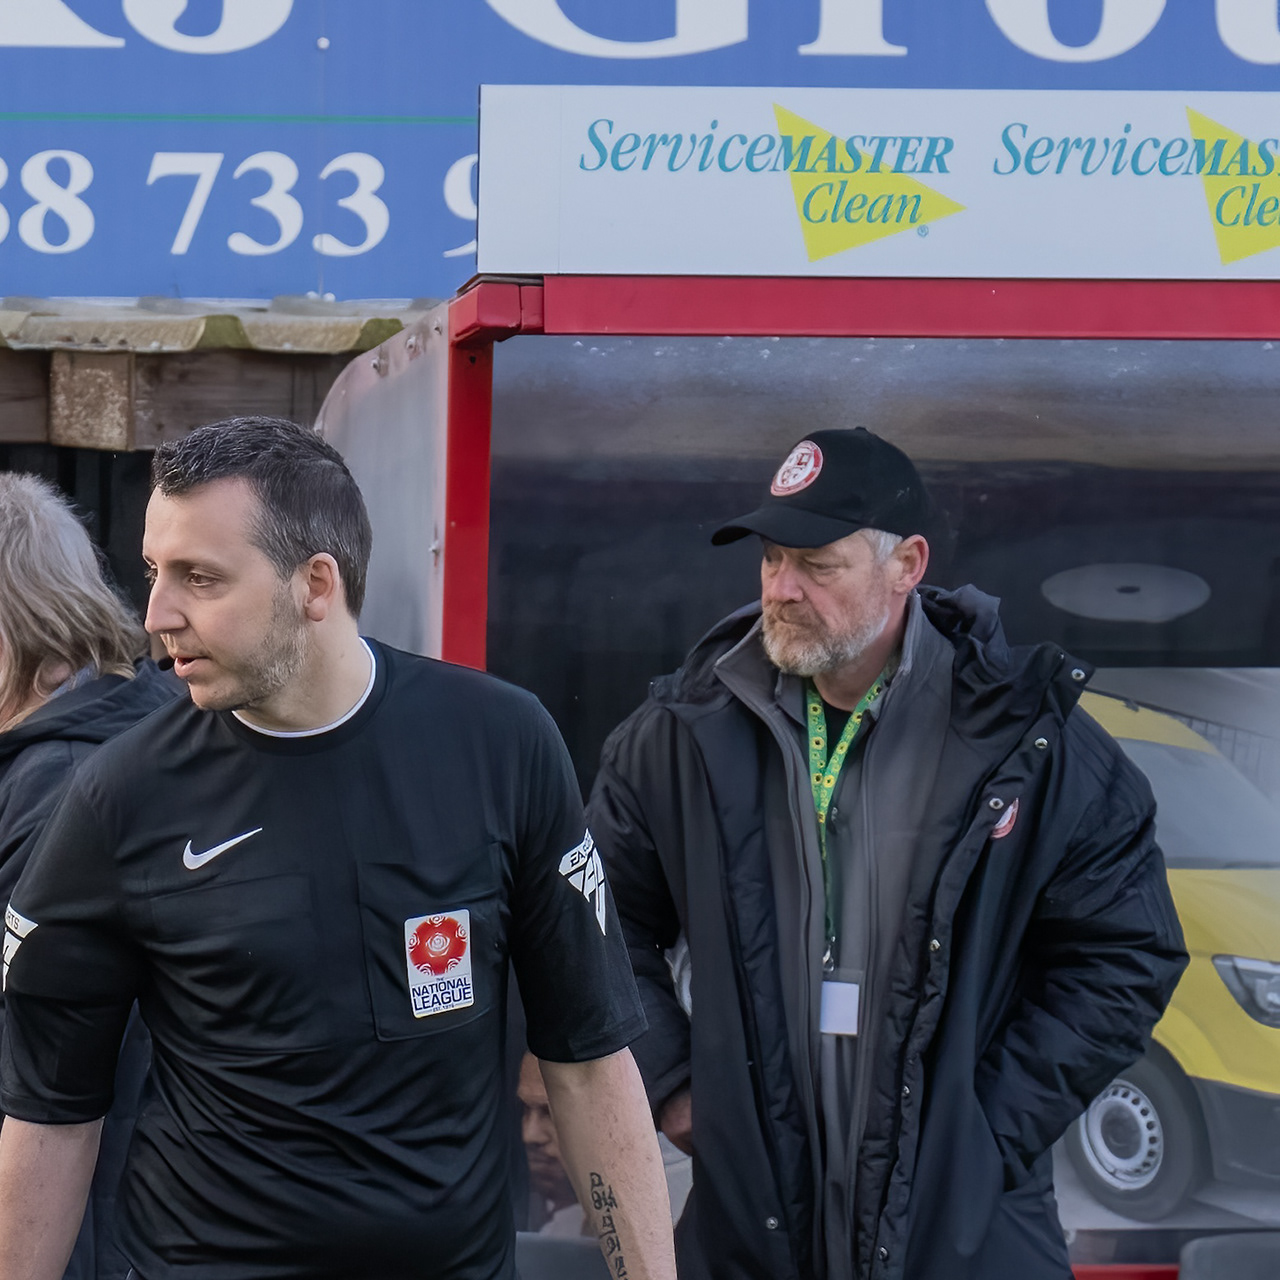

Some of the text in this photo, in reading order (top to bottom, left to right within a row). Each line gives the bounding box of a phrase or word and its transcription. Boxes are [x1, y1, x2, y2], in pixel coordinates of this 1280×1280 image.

[580, 118, 954, 174] ServiceMASTER
[145, 151, 390, 257] 733
[802, 180, 922, 224] Clean
[412, 977, 471, 997] NATIONAL
[414, 986, 473, 1011] LEAGUE
